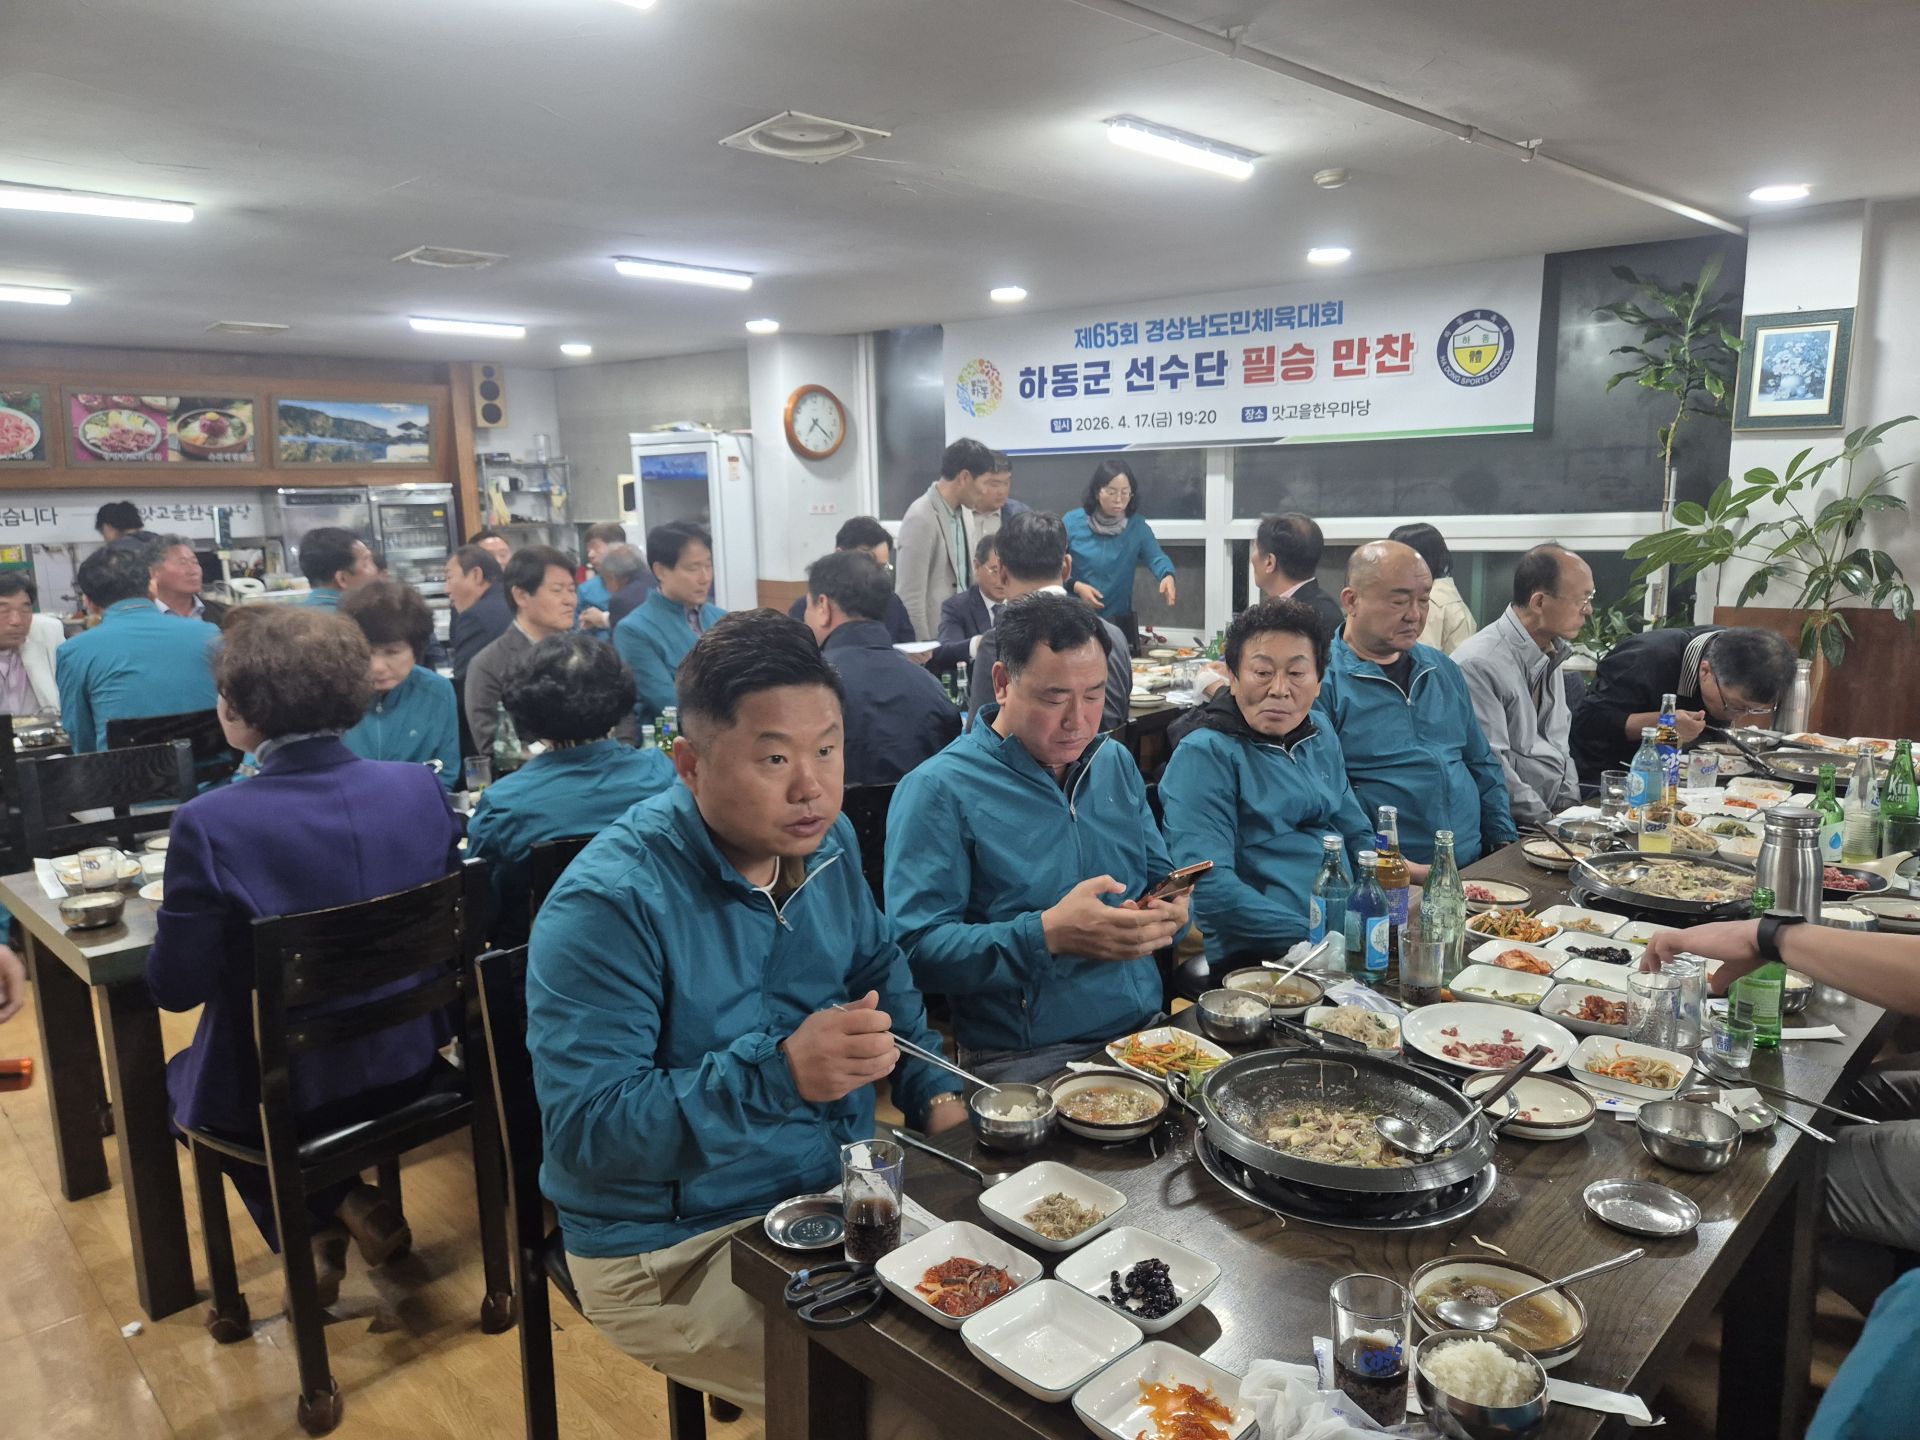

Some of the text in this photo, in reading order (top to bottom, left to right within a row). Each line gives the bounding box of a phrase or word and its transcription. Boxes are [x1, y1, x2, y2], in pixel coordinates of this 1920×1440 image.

[1074, 300, 1344, 349] 제65회 경상남도민체육대회
[1019, 333, 1415, 399] 하동군 선수단 필승 만찬
[1052, 420, 1071, 431] 일시
[1076, 416, 1113, 431] 2026.
[1118, 416, 1130, 429] 4.
[1177, 409, 1217, 425] 19:20
[1244, 399, 1371, 421] 장소 맛고을한우마당
[1888, 773, 1911, 796] Kin
